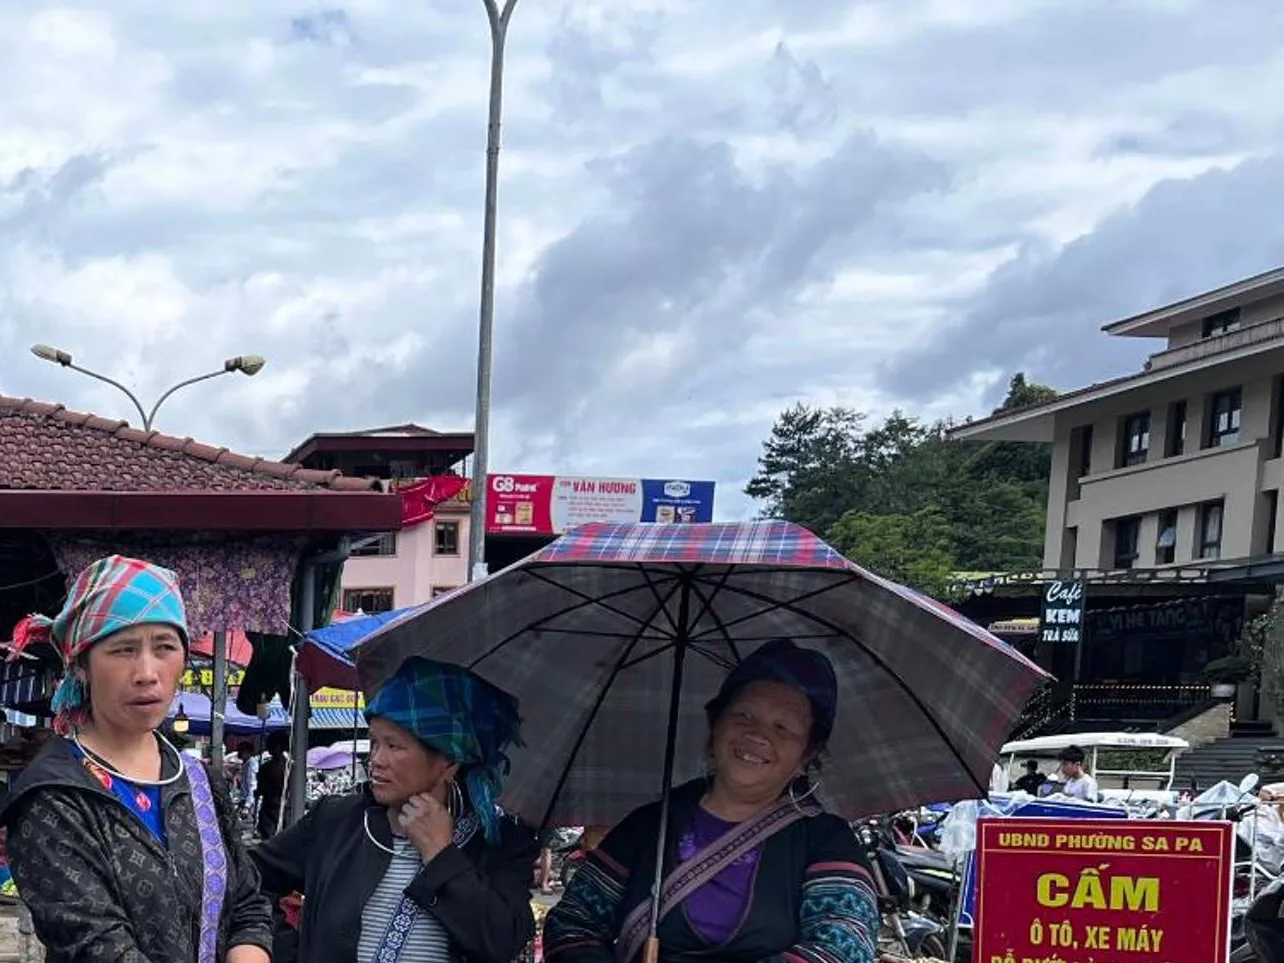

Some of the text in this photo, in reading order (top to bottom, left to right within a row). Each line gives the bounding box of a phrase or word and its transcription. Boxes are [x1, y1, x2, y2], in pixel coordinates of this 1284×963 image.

[1047, 581, 1083, 605] Café
[1046, 609, 1081, 623] KEM
[999, 832, 1204, 852] UBND PHƯỜNG SA PA
[1036, 863, 1160, 912] CẤM
[1030, 918, 1163, 953] Ô TÔ, XE MÁY
